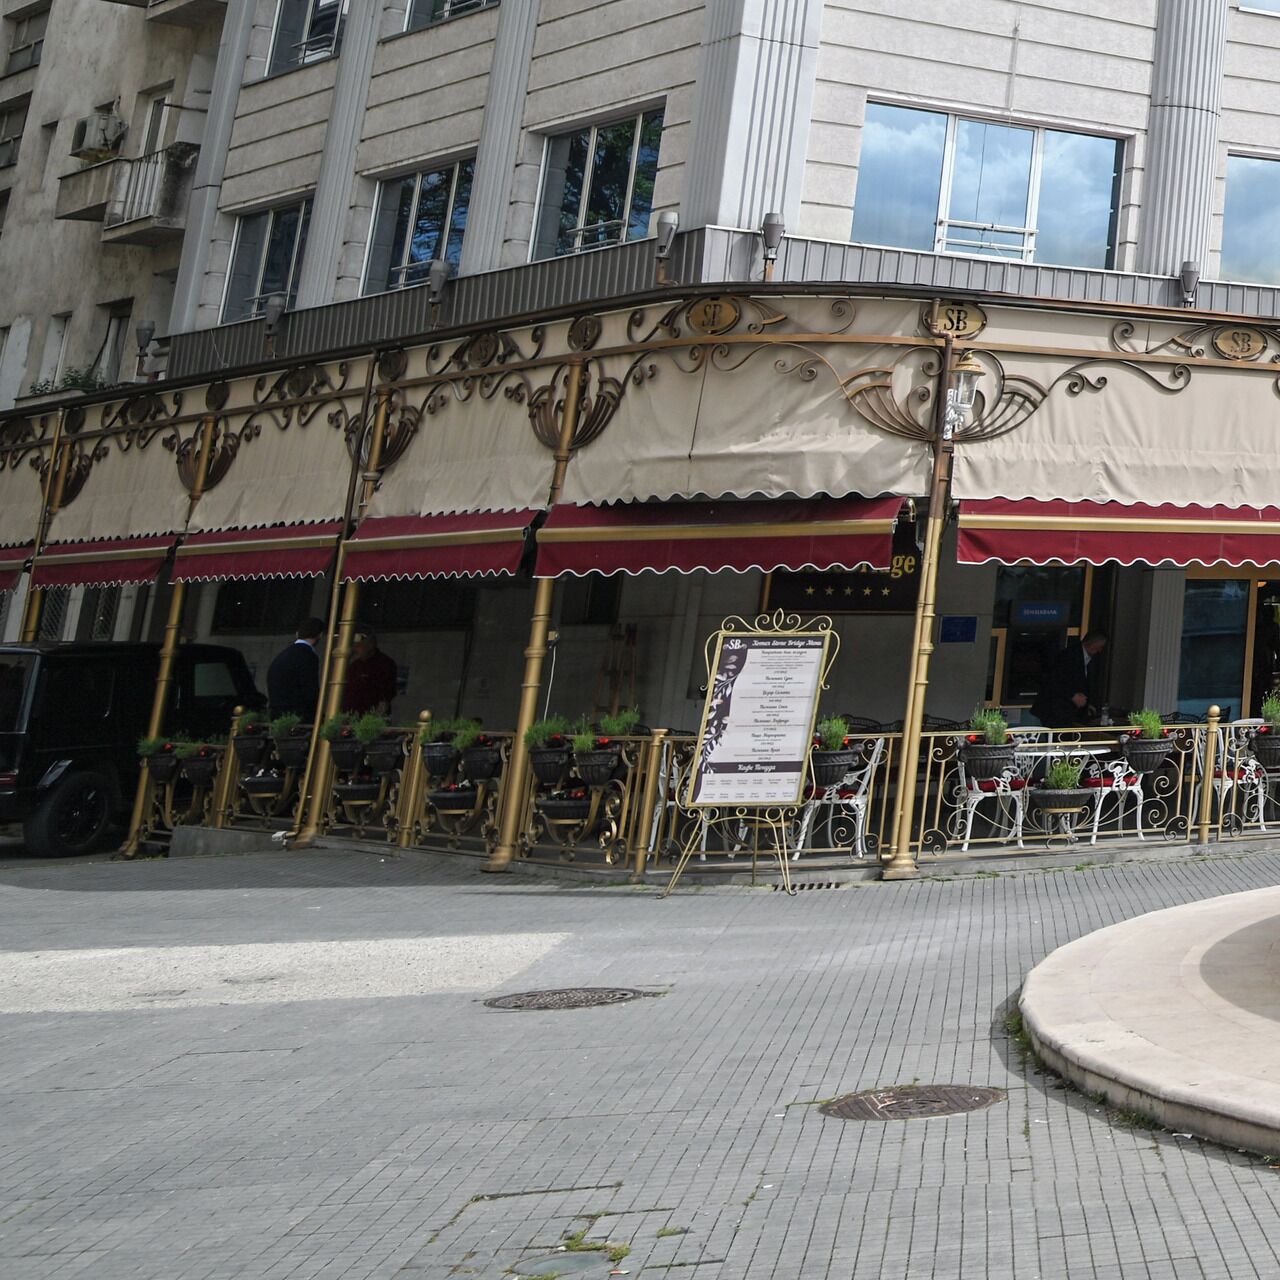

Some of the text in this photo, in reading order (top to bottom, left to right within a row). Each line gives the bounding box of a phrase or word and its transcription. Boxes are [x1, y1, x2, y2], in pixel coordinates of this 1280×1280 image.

[943, 308, 968, 331] SB
[1230, 331, 1251, 352] SB
[728, 639, 741, 650] SB
